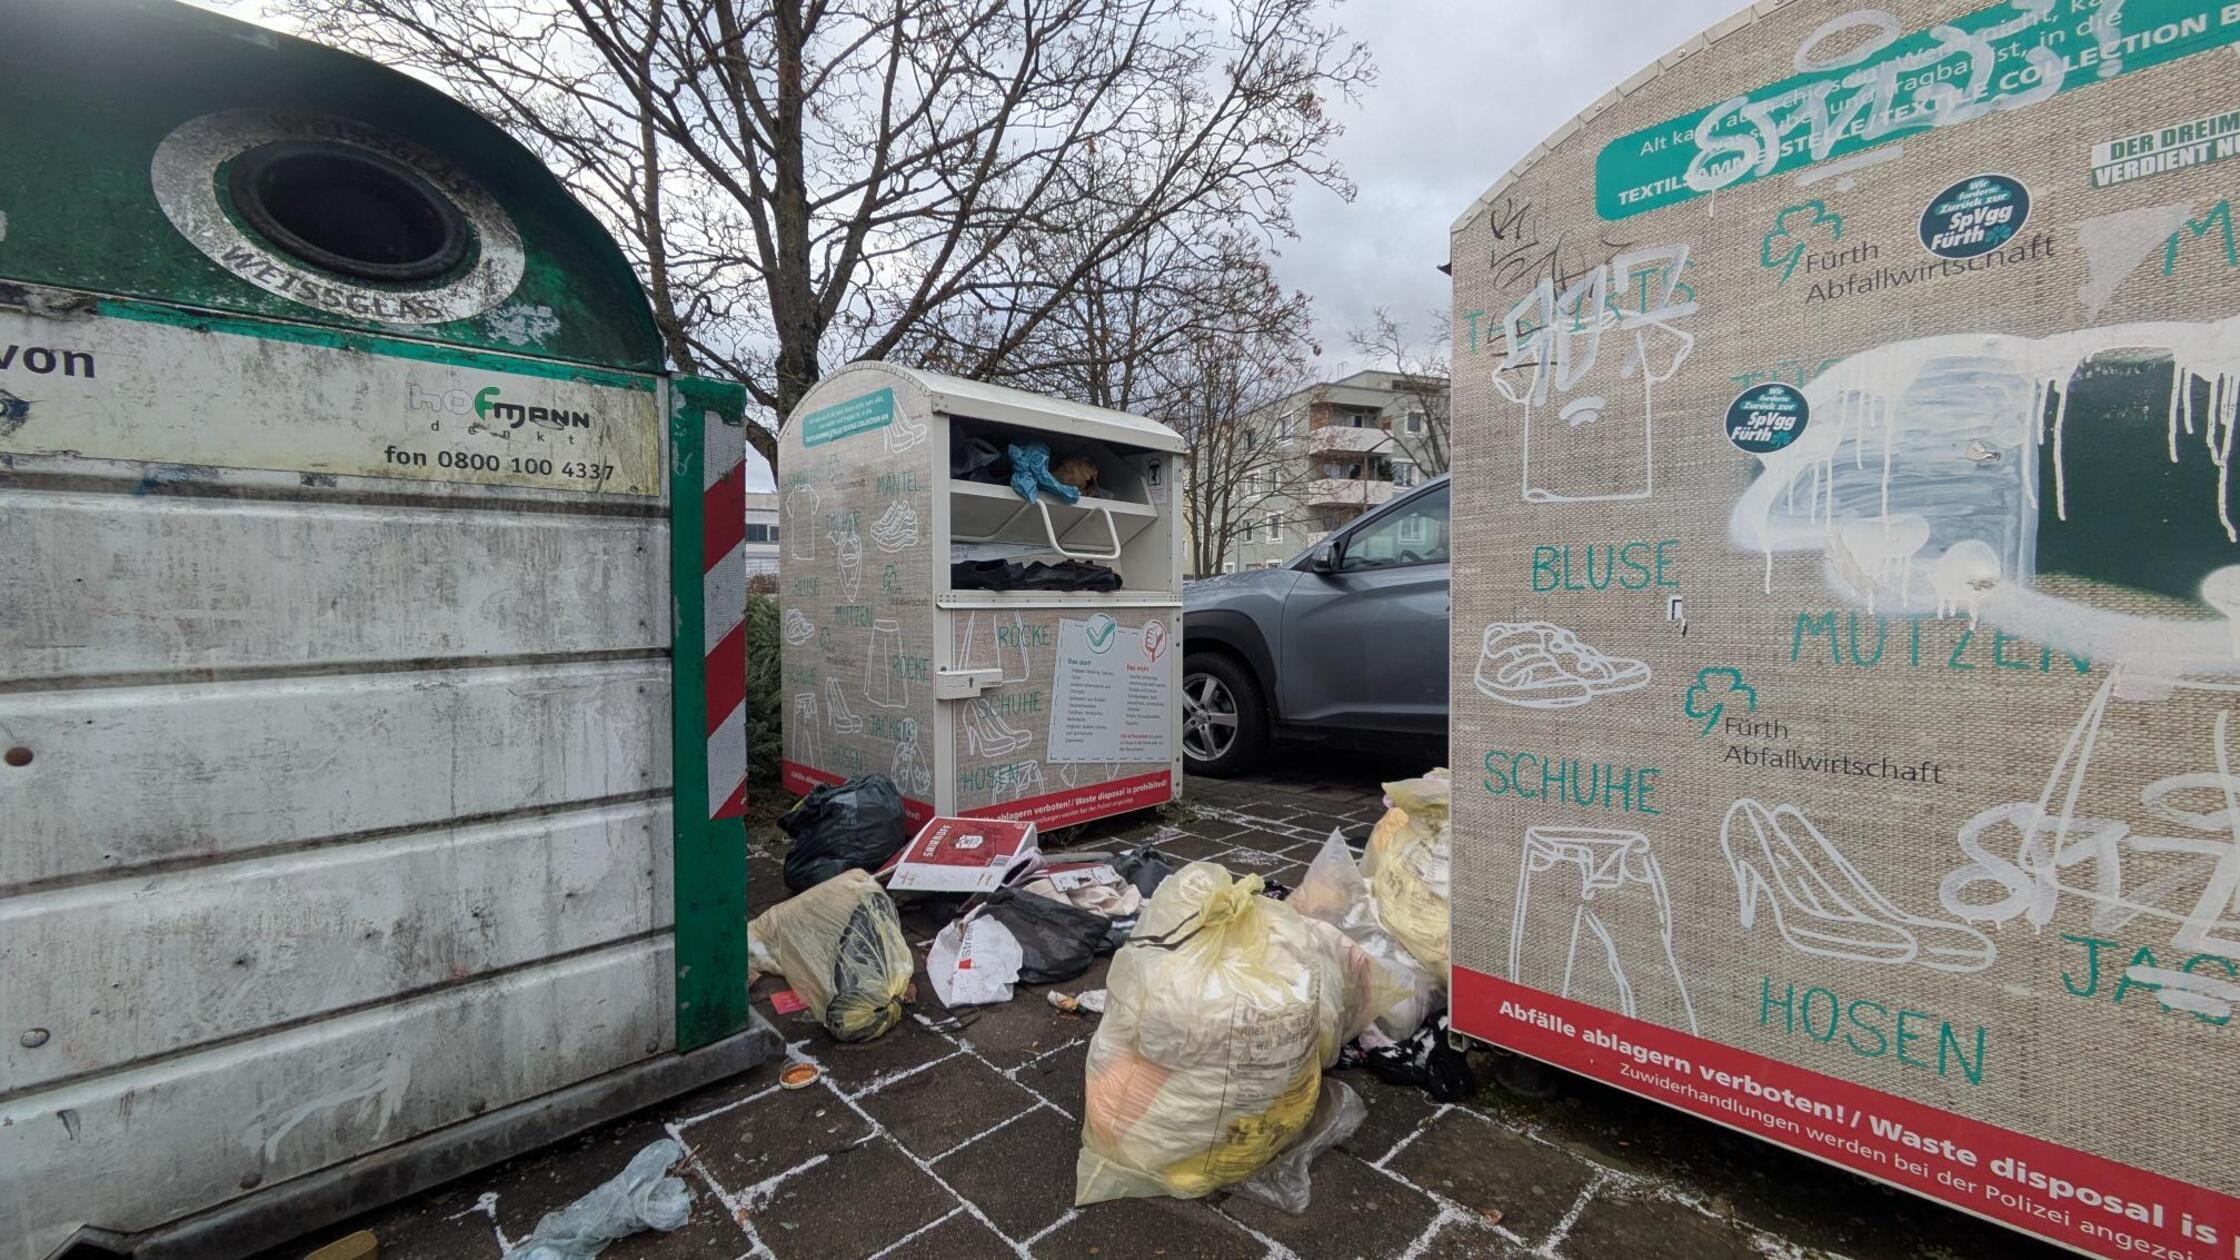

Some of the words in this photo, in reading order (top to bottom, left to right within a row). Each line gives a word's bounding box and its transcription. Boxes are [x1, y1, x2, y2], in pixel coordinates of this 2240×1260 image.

[1882, 58, 1982, 96] ragba
[1989, 42, 2027, 65] st,
[2040, 31, 2065, 49] in
[2076, 12, 2122, 36] die
[1999, 13, 2207, 90] COLLECTION
[1640, 137, 1668, 157] Alt
[1673, 123, 1719, 147] kan
[2110, 134, 2154, 161] DER
[2095, 143, 2213, 187] VERDIENT
[1969, 178, 1989, 190] Wir
[1937, 198, 1983, 215] Zurück
[1985, 193, 2008, 205] zur
[1949, 205, 2014, 232] SpVgg
[1931, 225, 1985, 250] Fürth
[1807, 241, 1878, 273] Fürth
[220, 245, 443, 320] WEISSGLAS
[1742, 401, 1775, 411] Zurück
[1769, 387, 1784, 395] Wir
[1731, 427, 1772, 442] Fürth
[1747, 412, 1797, 431] SpVgg
[384, 445, 427, 467] fon
[437, 450, 500, 472] 0800
[511, 457, 553, 476] 100
[561, 461, 615, 481] 4337
[1532, 538, 1682, 592] BLUSE
[978, 690, 1042, 720] SCHUHE
[1725, 716, 1788, 740] Fürth
[961, 762, 1020, 792] HOSEN
[1723, 745, 1944, 784] Abfallwirtschaft
[1482, 750, 1664, 816] SCHUHE
[1761, 976, 1987, 1086] HOSEN
[1499, 1001, 1577, 1038] Abfälle
[1582, 1030, 1693, 1075] ablagern
[1699, 1064, 1845, 1123] verboten!
[1869, 1115, 1978, 1167] Waste
[1990, 1157, 2164, 1228] disposal
[2181, 1213, 2218, 1245] is
[1619, 1063, 1800, 1135] Zuwiderhandlungen
[1806, 1126, 1887, 1164] werden
[1894, 1153, 1929, 1179] bei
[1937, 1170, 1978, 1194] der
[1985, 1184, 2070, 1227] Polizei
